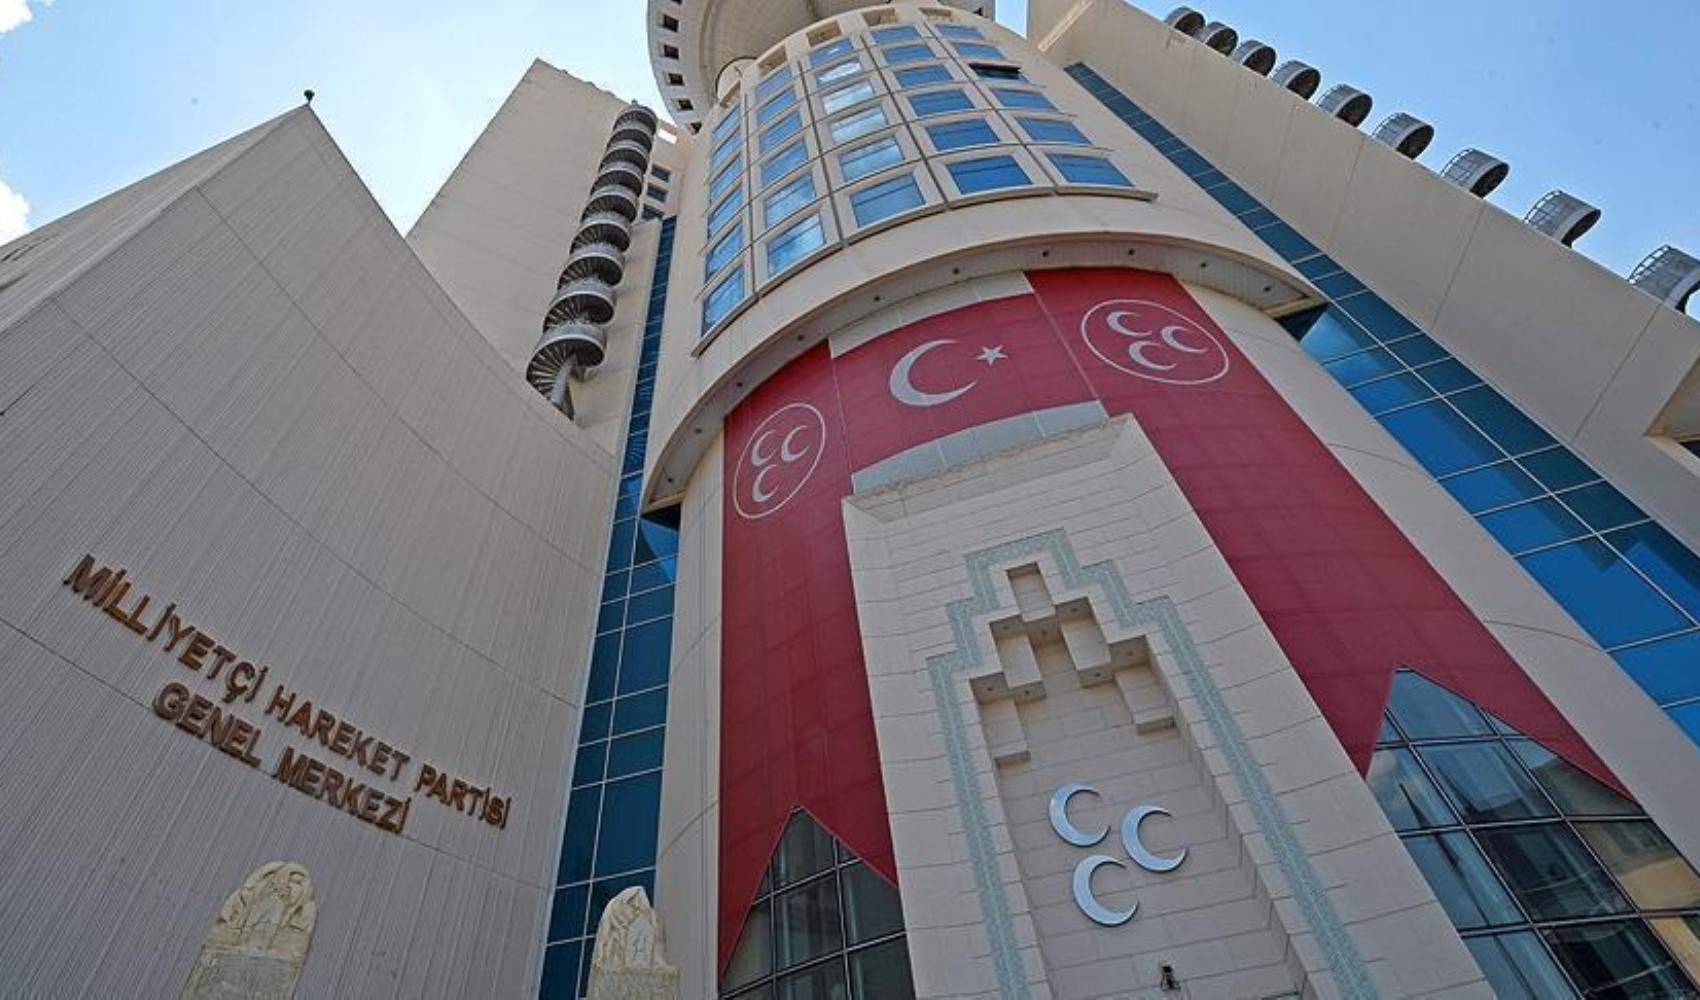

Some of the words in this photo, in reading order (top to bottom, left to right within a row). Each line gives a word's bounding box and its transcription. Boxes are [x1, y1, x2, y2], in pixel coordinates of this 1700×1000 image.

[62, 553, 269, 704] MİLLİYETÇİ
[264, 684, 411, 782] HAREKET
[414, 763, 512, 829] PARTİSİ
[153, 682, 262, 768] GENEL
[271, 746, 412, 835] MERKEZİ
